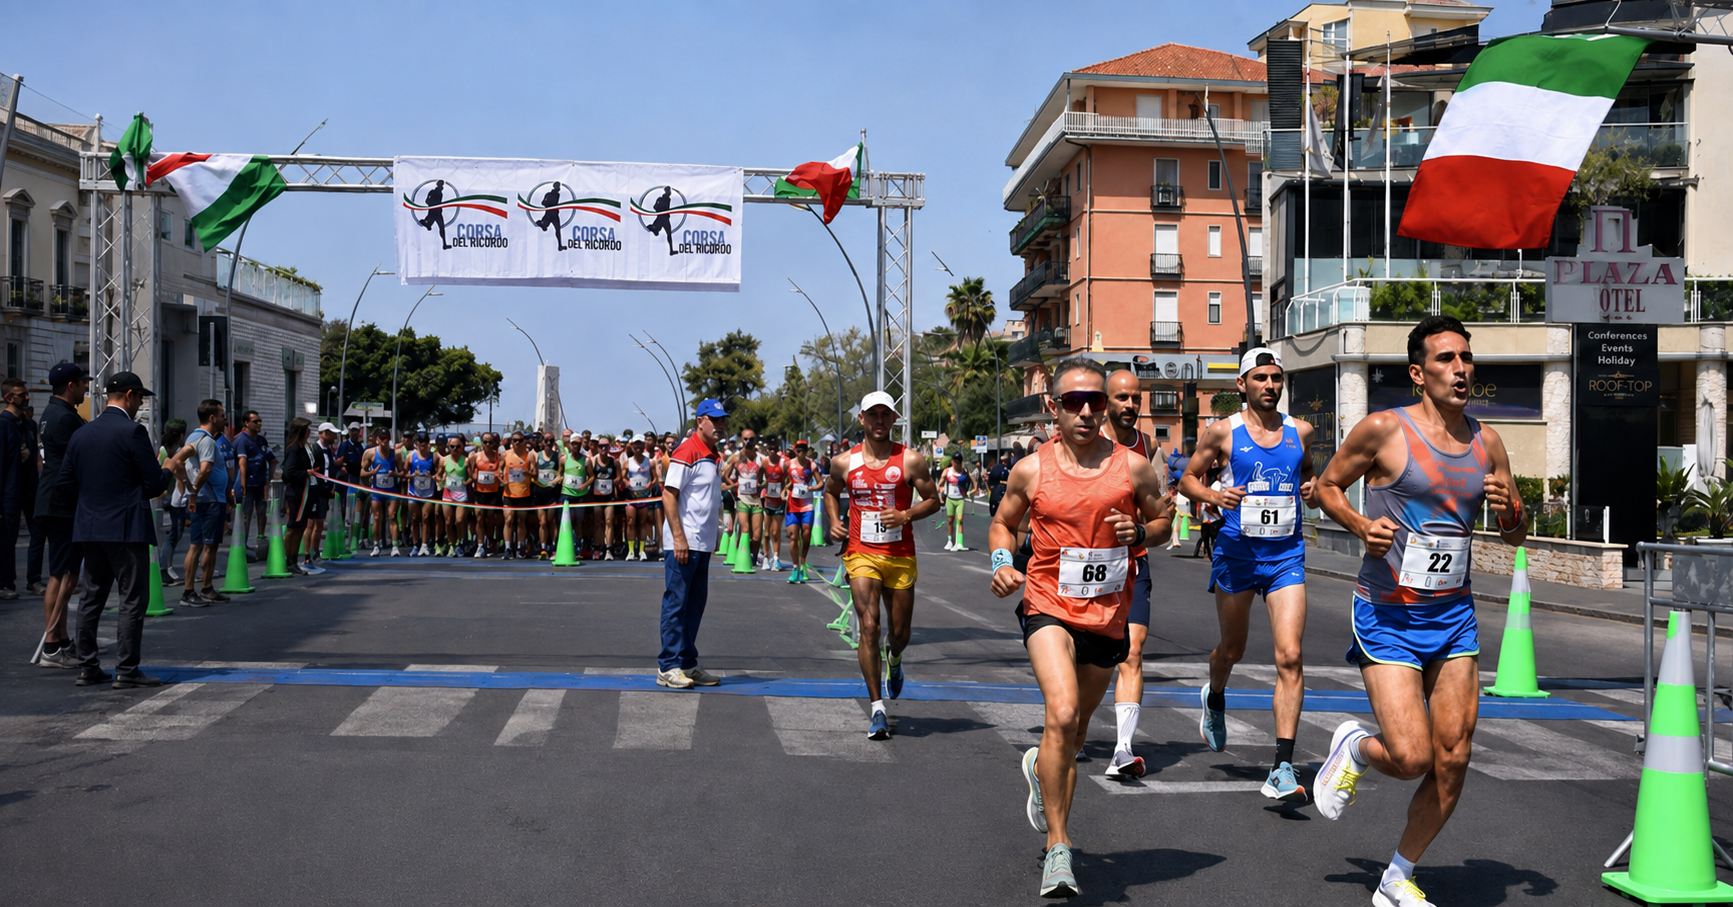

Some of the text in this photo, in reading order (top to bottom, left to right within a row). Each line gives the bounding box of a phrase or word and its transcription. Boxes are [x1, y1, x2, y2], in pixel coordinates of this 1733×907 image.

[457, 223, 502, 240] CORSA
[572, 225, 616, 242] CORSA
[683, 229, 725, 246] CORSA
[453, 237, 508, 248] DEL RICORDO
[568, 239, 621, 251] DEL RICORDO
[679, 243, 731, 255] DEL RICORDO
[1553, 260, 1678, 285] PLAZA
[1588, 330, 1647, 340] Conferences
[1601, 343, 1633, 353] Events
[1598, 355, 1635, 367] Holiday
[1589, 379, 1652, 393] ROOF-TOP
[1261, 509, 1278, 525] 61
[1427, 552, 1452, 573] 22
[1082, 564, 1107, 582] 68
